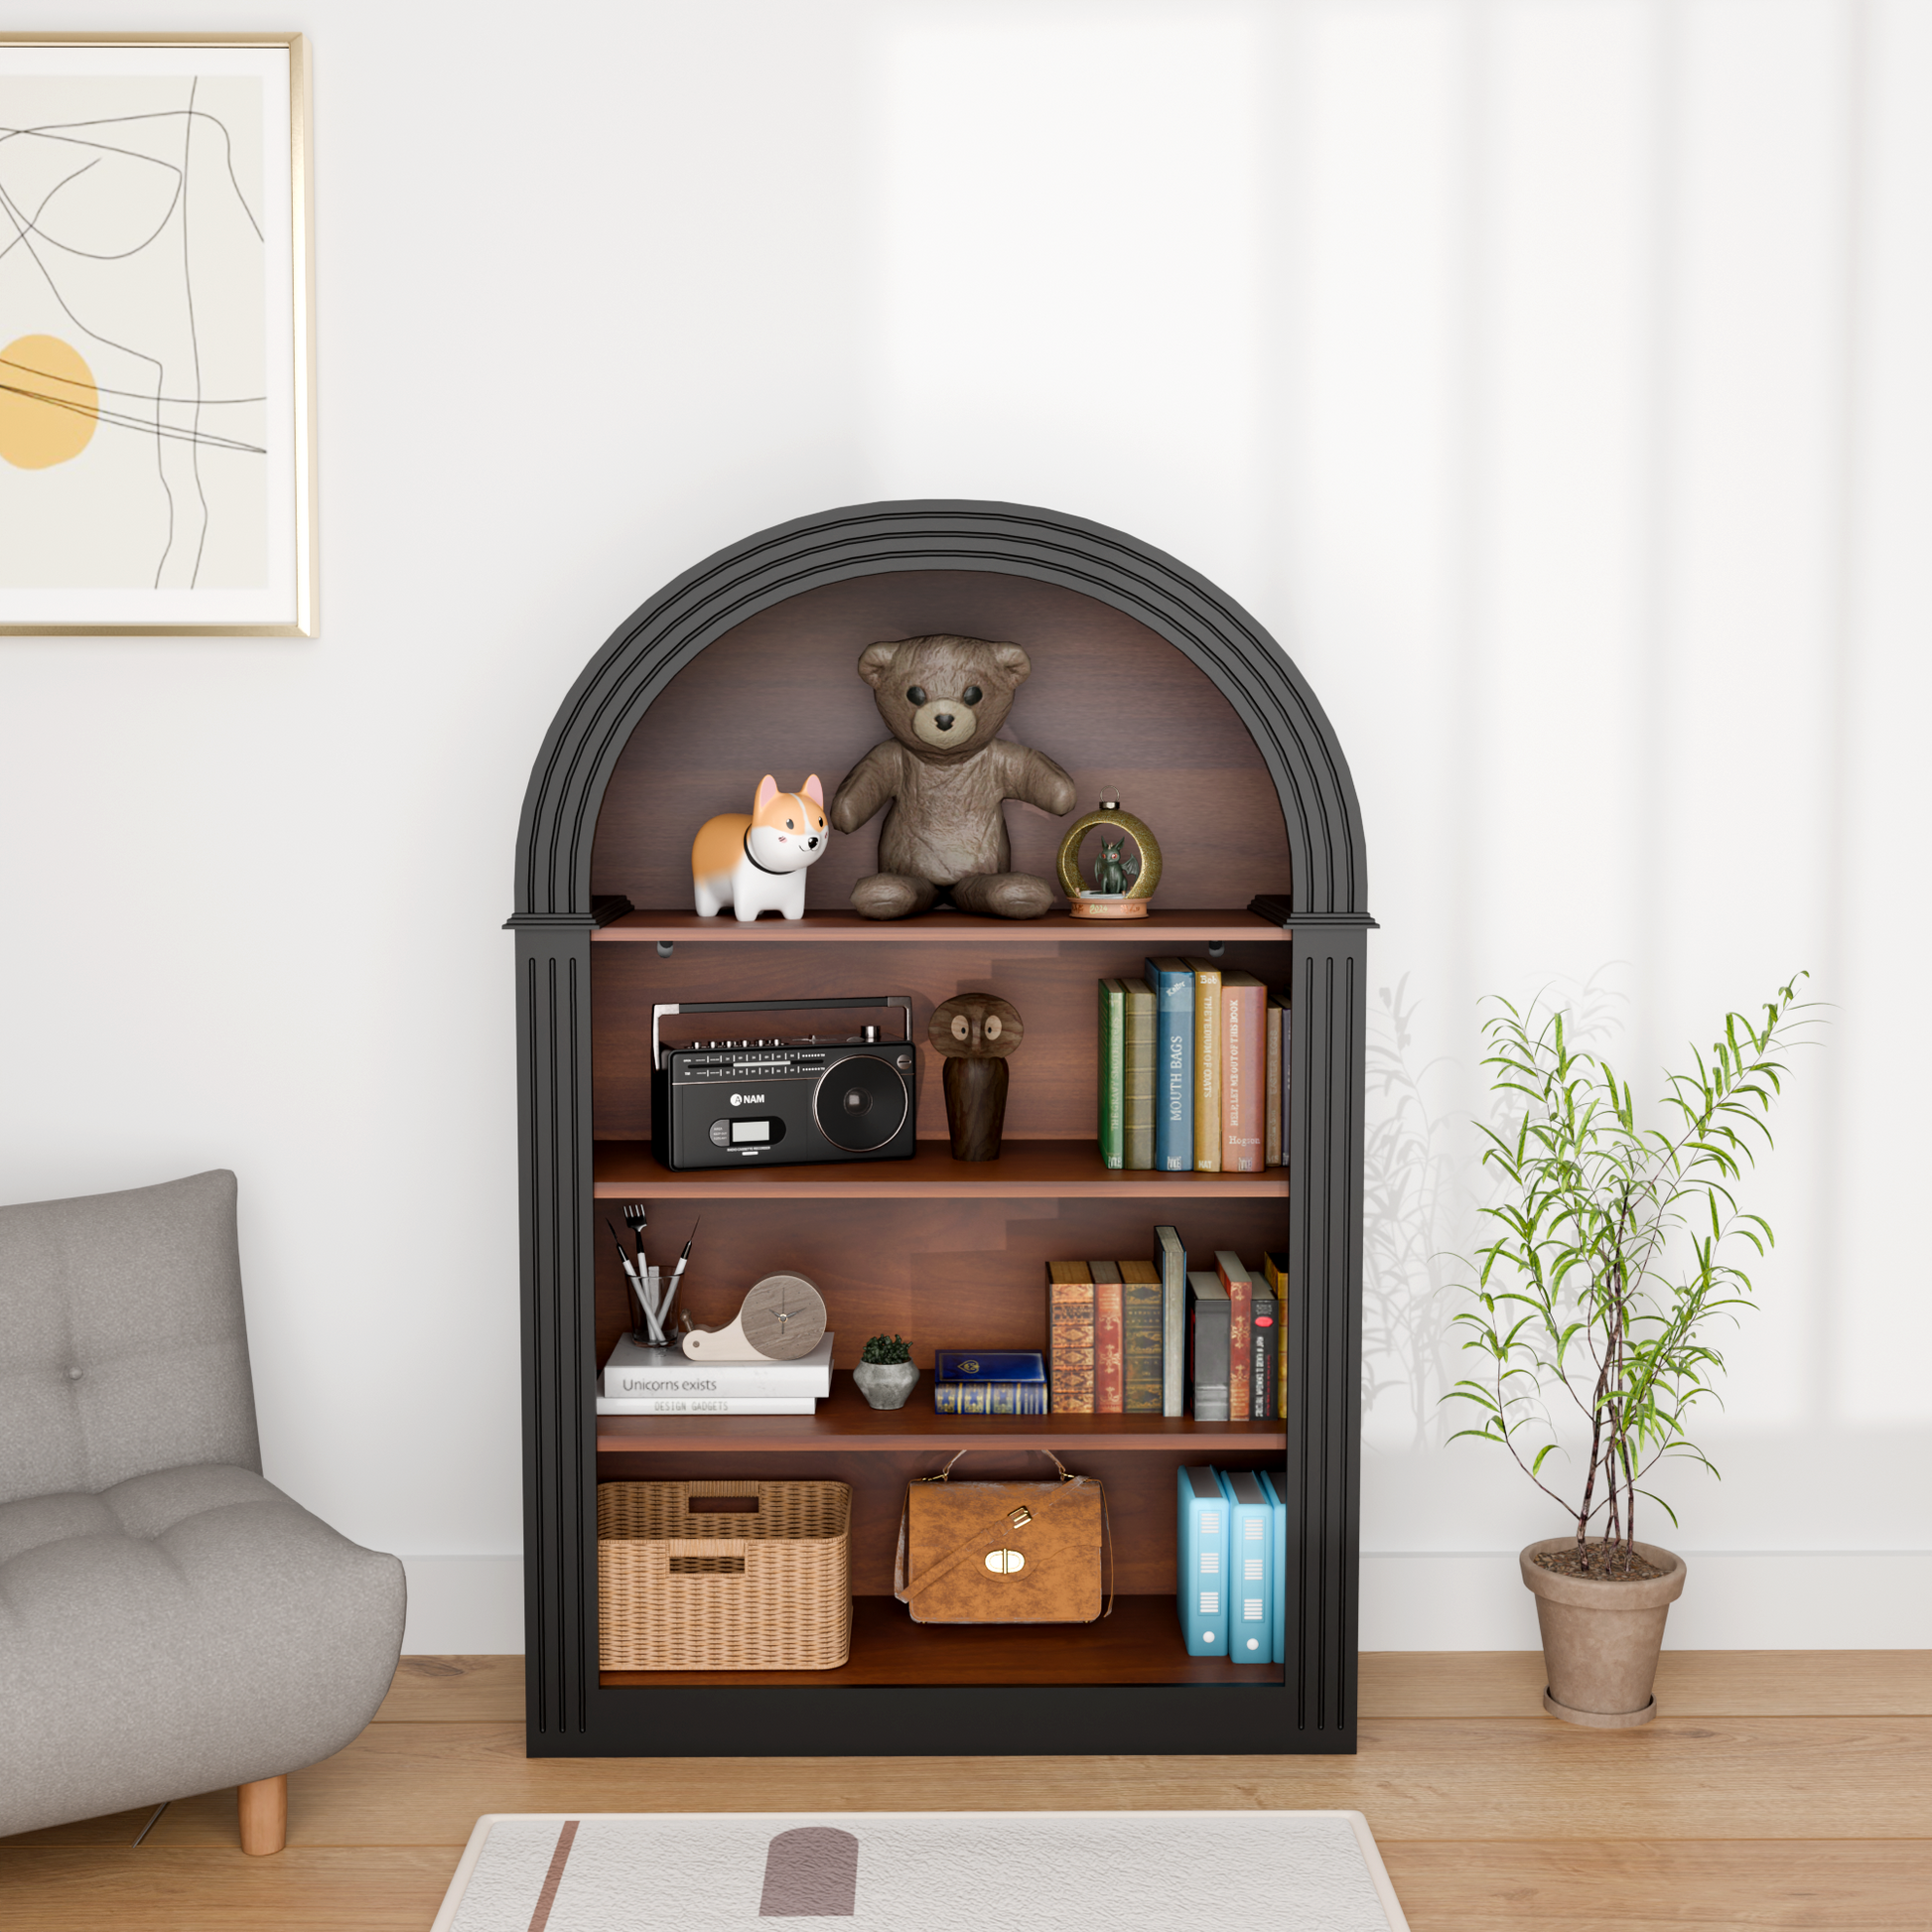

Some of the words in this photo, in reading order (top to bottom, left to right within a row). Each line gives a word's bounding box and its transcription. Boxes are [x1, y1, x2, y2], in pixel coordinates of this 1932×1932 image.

[1200, 975, 1217, 984] Bob
[1203, 996, 1212, 1016] THE
[1203, 1017, 1212, 1053] TEDIUM
[1171, 1035, 1182, 1069] BAGS
[1230, 1044, 1238, 1055] OF
[1203, 1054, 1212, 1067] OF
[1230, 1074, 1238, 1087] ME
[744, 1094, 764, 1104] NAM
[1171, 1073, 1181, 1121] MOUTH
[622, 1378, 679, 1392] Unicorns
[681, 1378, 717, 1391] exists
[654, 1401, 687, 1412] DESIGN
[691, 1401, 729, 1412] GADGETS
